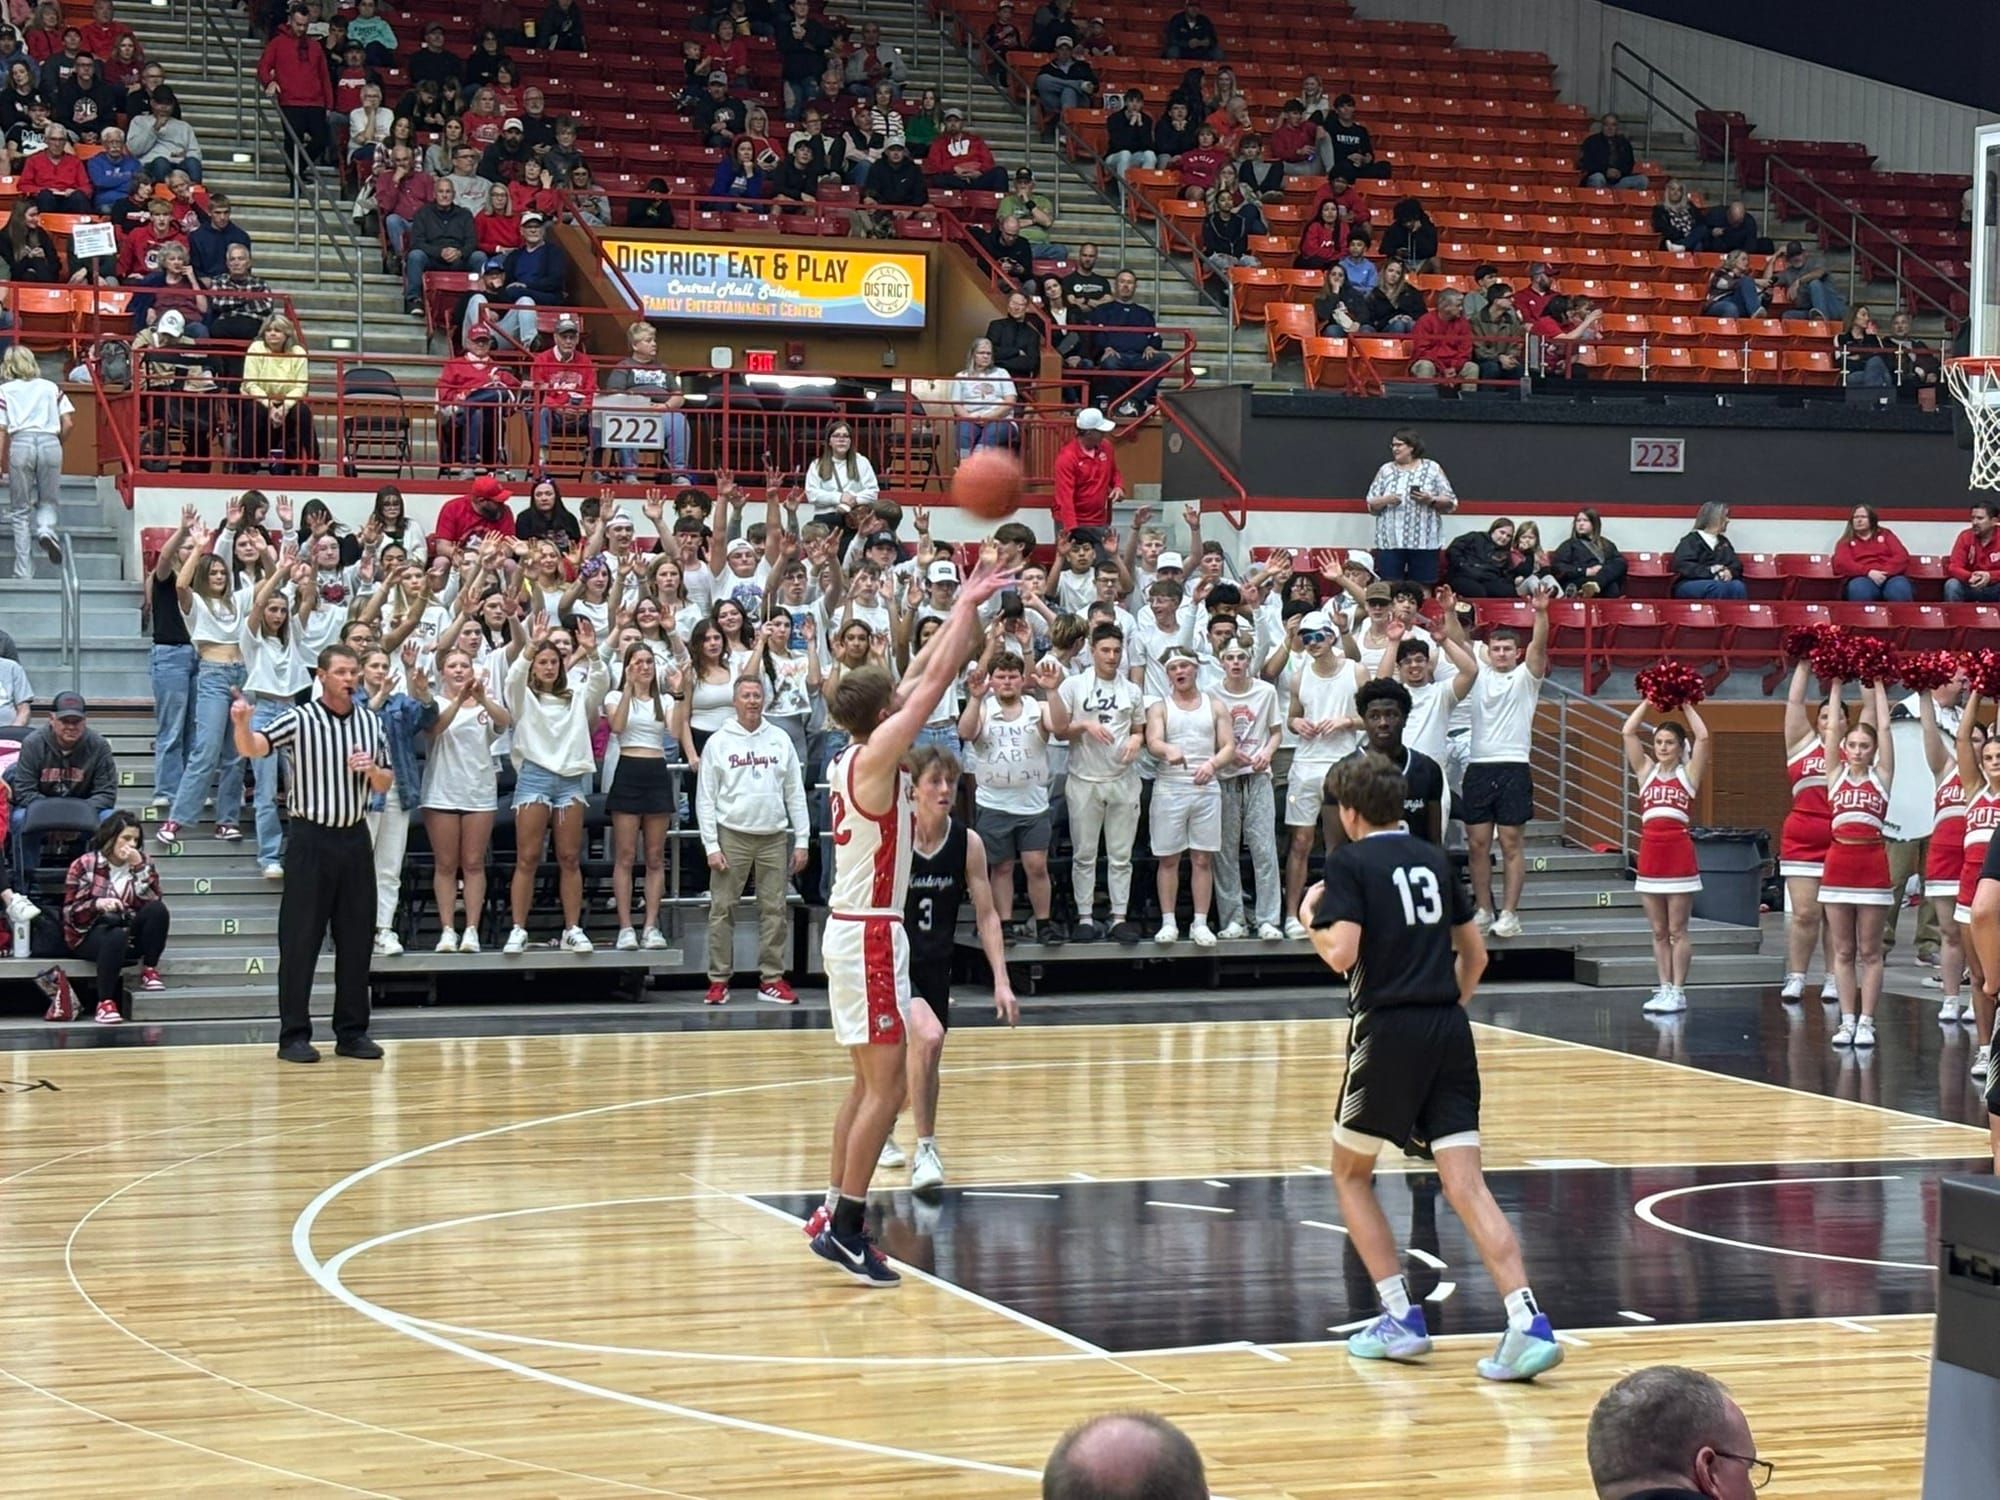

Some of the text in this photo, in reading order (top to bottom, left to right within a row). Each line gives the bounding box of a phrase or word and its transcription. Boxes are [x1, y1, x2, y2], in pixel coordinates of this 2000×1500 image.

[617, 245, 849, 283] DISTRICT EAT & PLAY
[667, 280, 715, 295] Central
[758, 283, 800, 300] Salina
[864, 282, 909, 298] DISTRICT
[643, 296, 823, 319] FAMILY ENTERTAINMENT CENTER
[749, 353, 774, 371] EXIT
[608, 417, 658, 443] 222
[1636, 444, 1679, 467] 223
[988, 724, 1036, 737] KING
[1802, 757, 1826, 775] PU
[121, 773, 132, 784] F
[1643, 785, 1690, 810] PUPS
[1832, 789, 1884, 814] PUPS
[1939, 785, 1966, 806] PU
[144, 808, 157, 820] E
[169, 842, 181, 855] D
[1534, 858, 1546, 870] C
[196, 880, 209, 893] C
[1392, 866, 1443, 925] 13
[918, 897, 933, 931] 3
[224, 920, 236, 933] B
[248, 959, 263, 973] A
